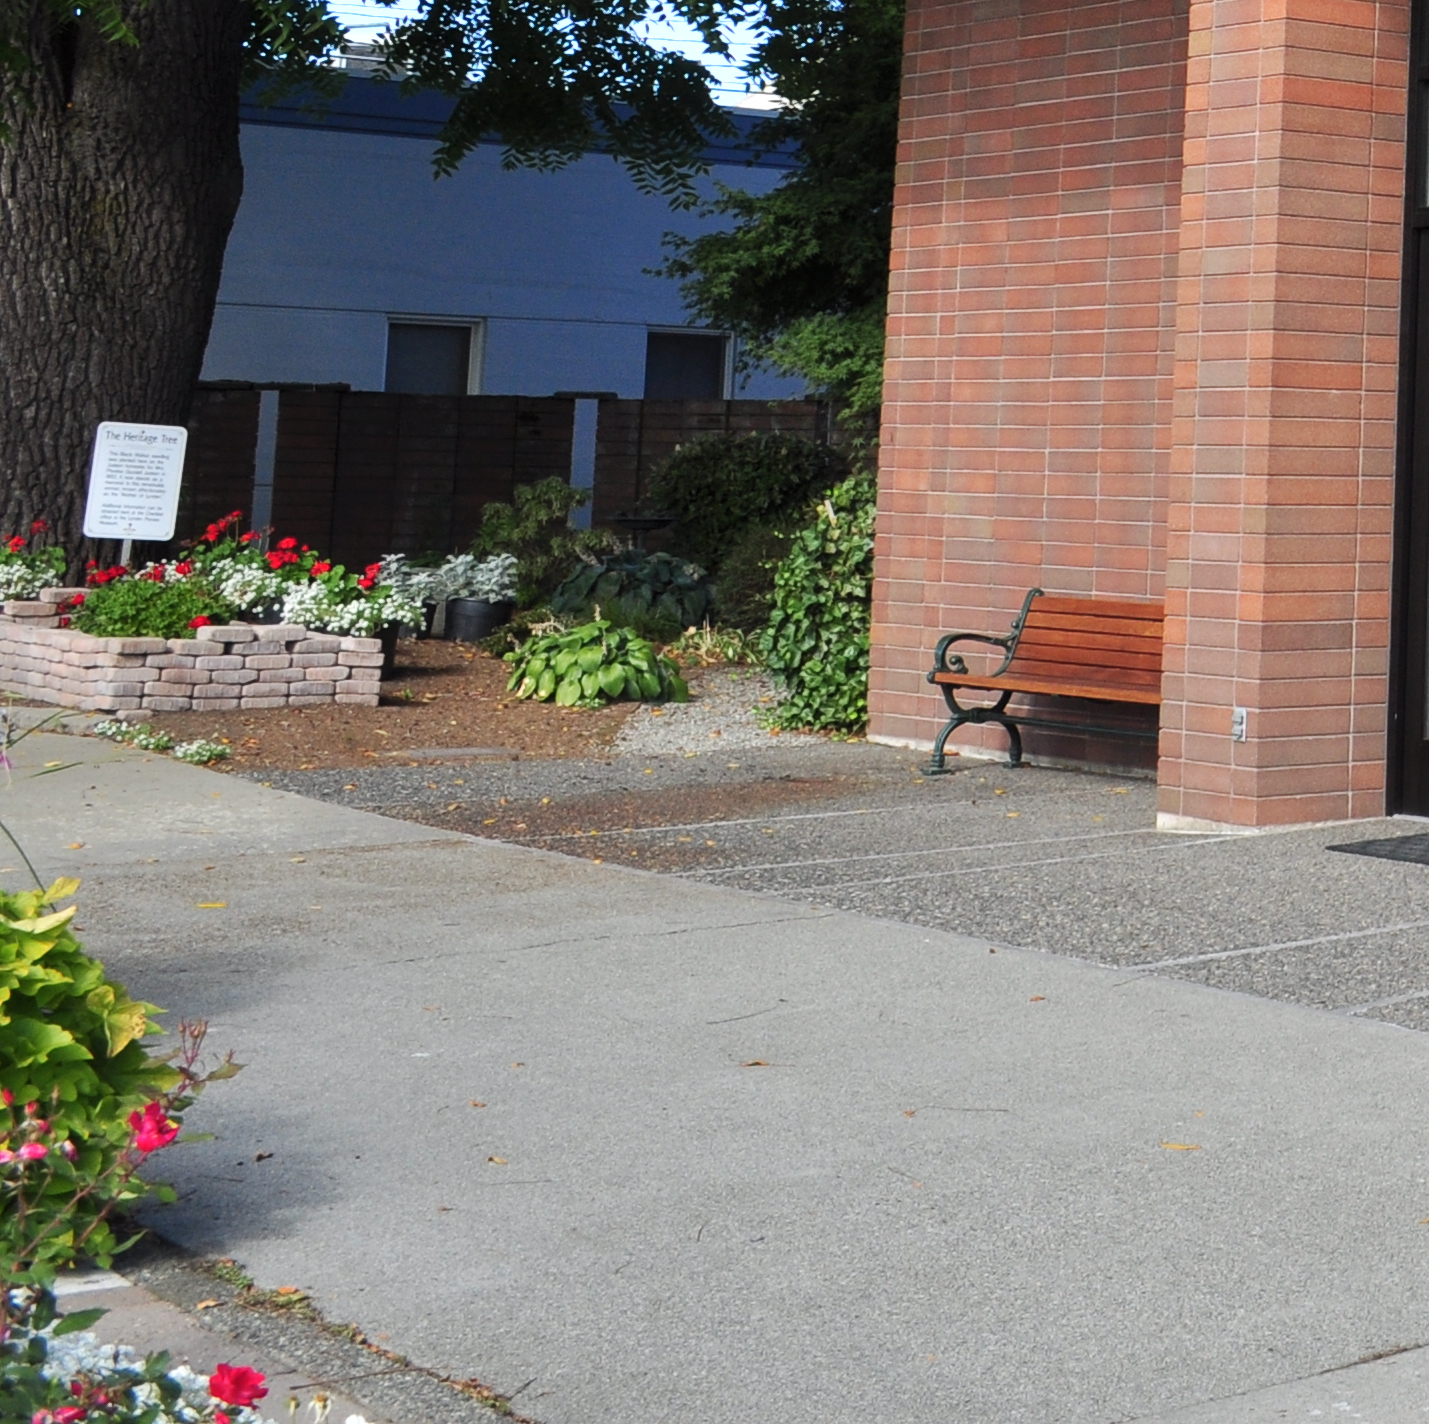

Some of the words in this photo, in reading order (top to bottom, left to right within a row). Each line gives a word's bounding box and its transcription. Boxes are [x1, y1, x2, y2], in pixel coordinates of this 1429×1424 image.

[106, 430, 121, 441] The
[123, 431, 158, 444] Heritage
[161, 433, 179, 445] Tree
